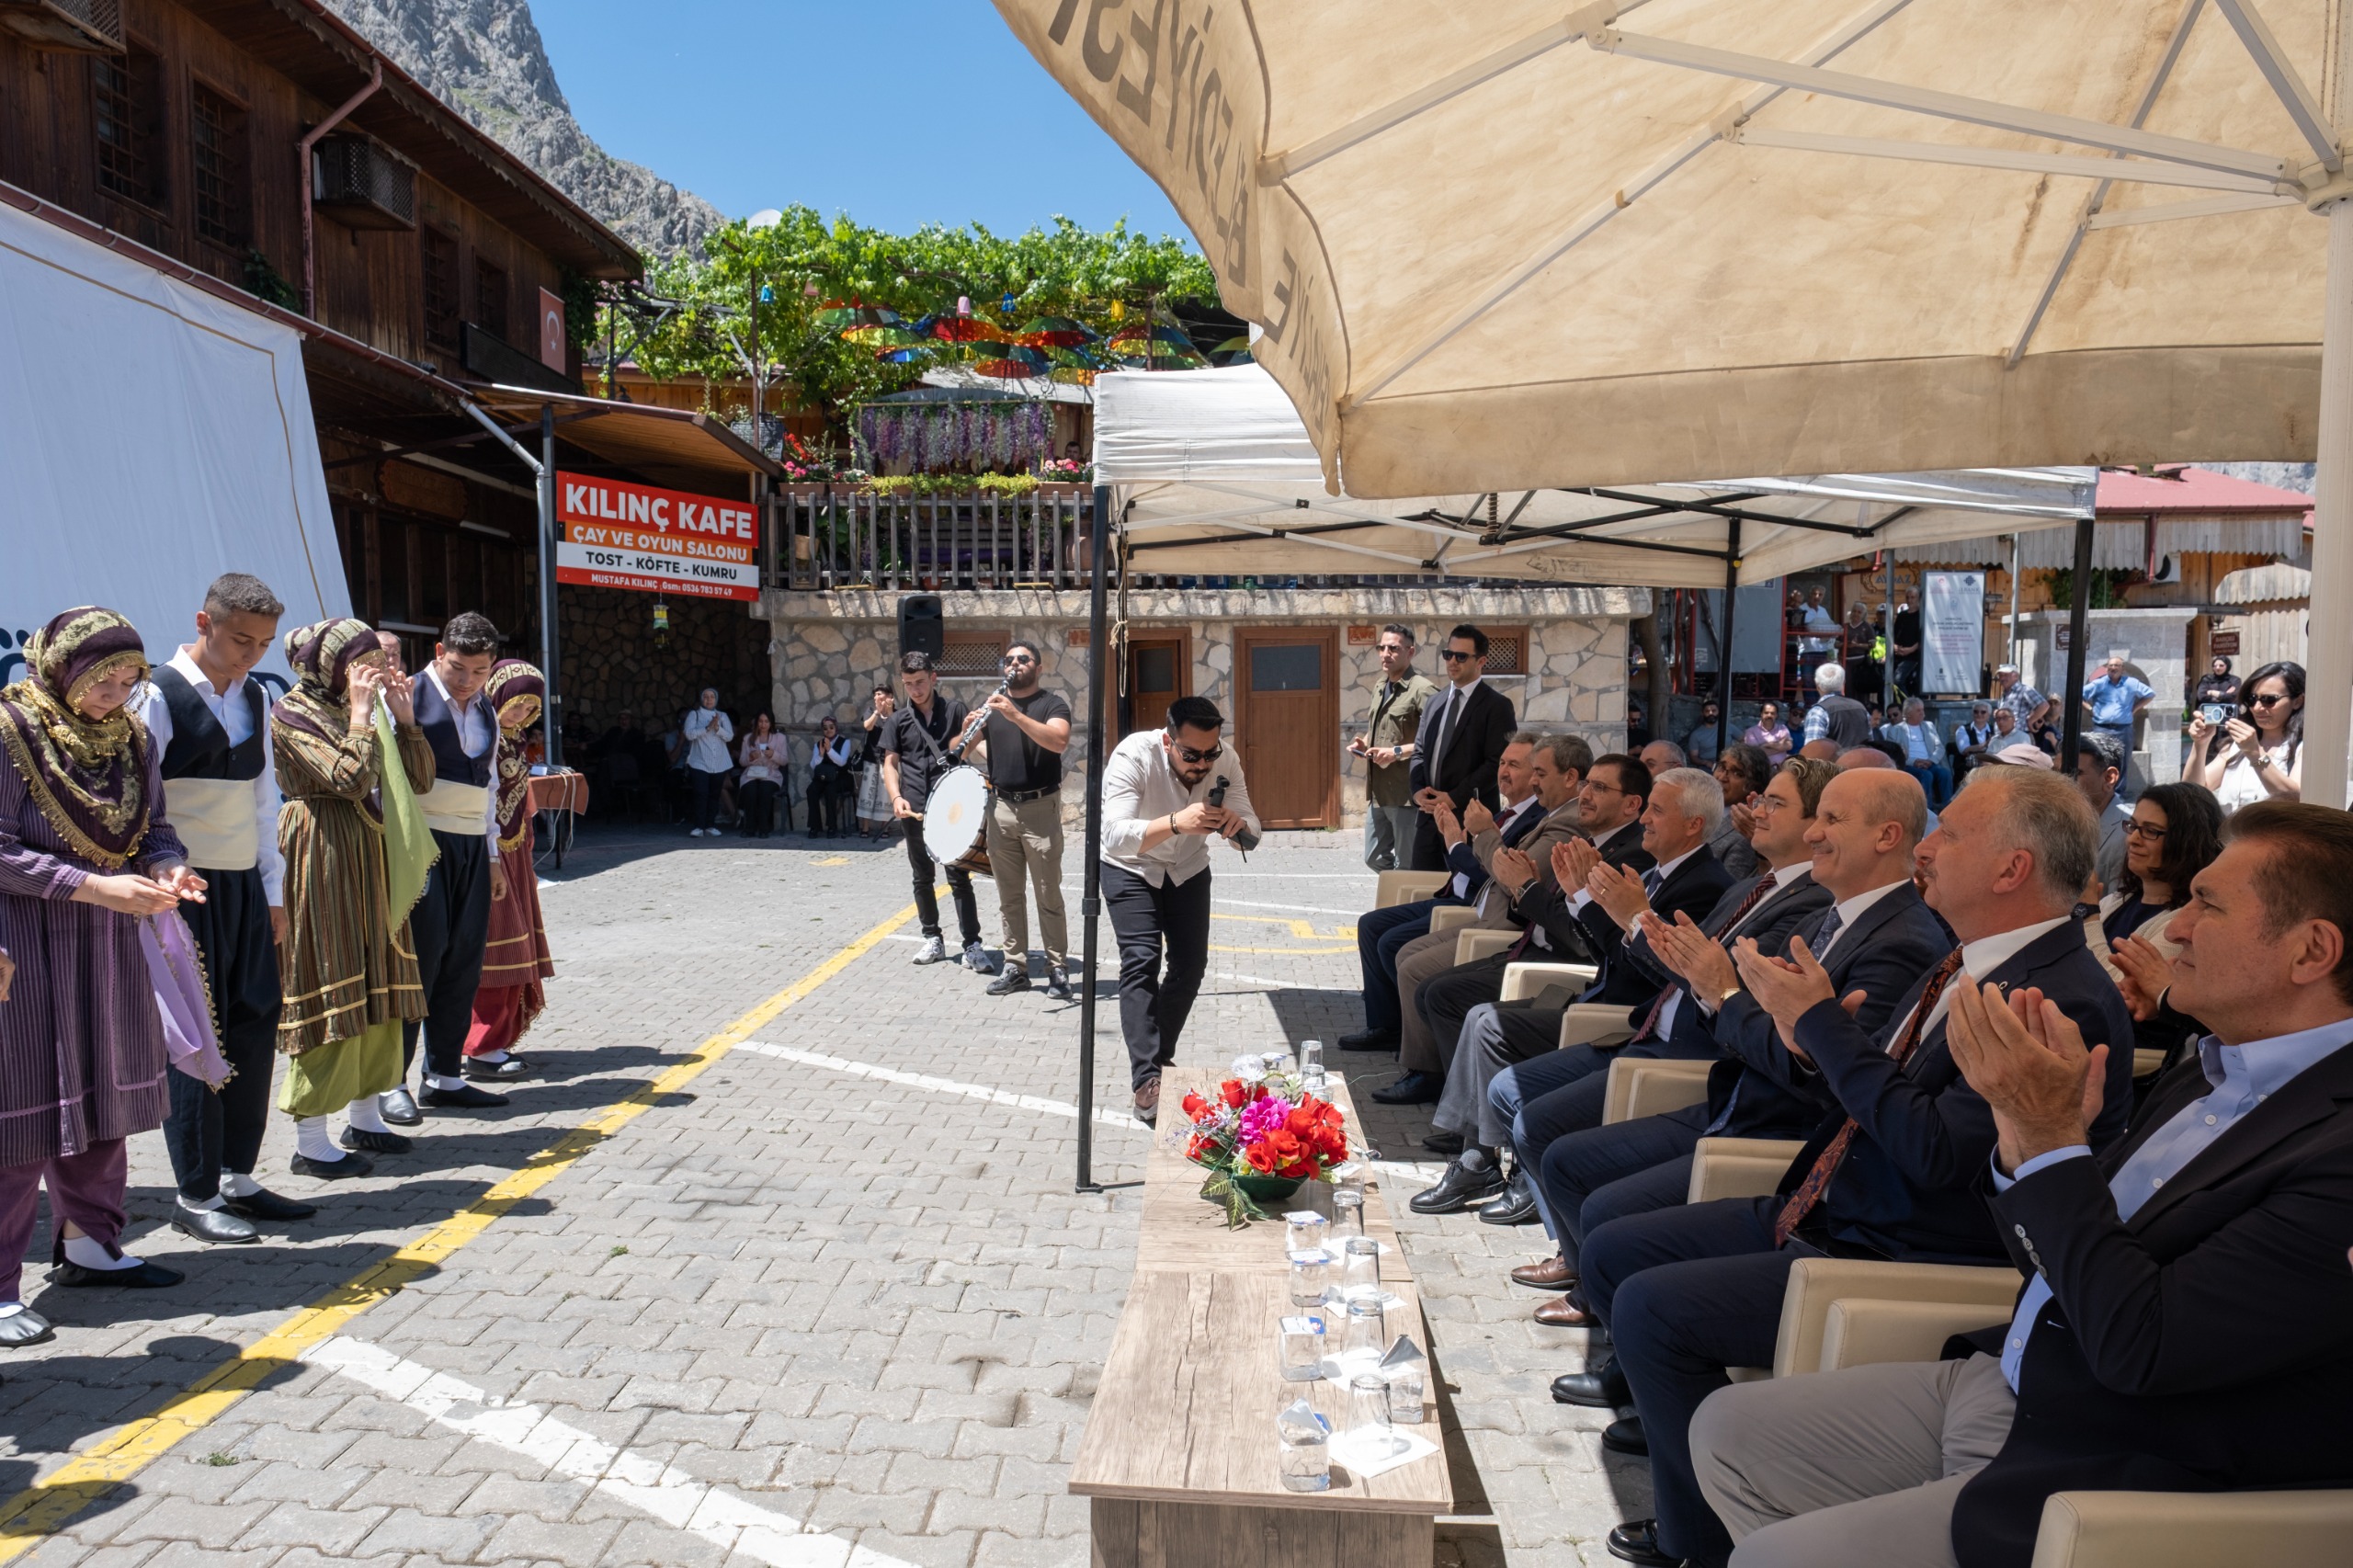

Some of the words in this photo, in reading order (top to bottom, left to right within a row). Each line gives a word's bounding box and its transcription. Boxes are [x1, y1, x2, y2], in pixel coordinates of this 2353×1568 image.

[566, 483, 670, 532] KILINÇ
[678, 501, 753, 540] KAFE
[573, 526, 608, 543] ÇAY
[610, 529, 634, 547] VE
[638, 534, 683, 553] OYUN
[687, 540, 747, 562] SALONU
[585, 551, 623, 567] TOST
[636, 555, 680, 574] KÖFTE
[692, 564, 737, 580] KUMRU
[591, 574, 631, 586] MUSTAFA
[631, 578, 658, 590] KILINÇ
[662, 581, 681, 592] Gsm:
[682, 583, 699, 594] 0536
[700, 585, 713, 595] 783
[714, 586, 723, 596] 57
[723, 587, 733, 597] 49
